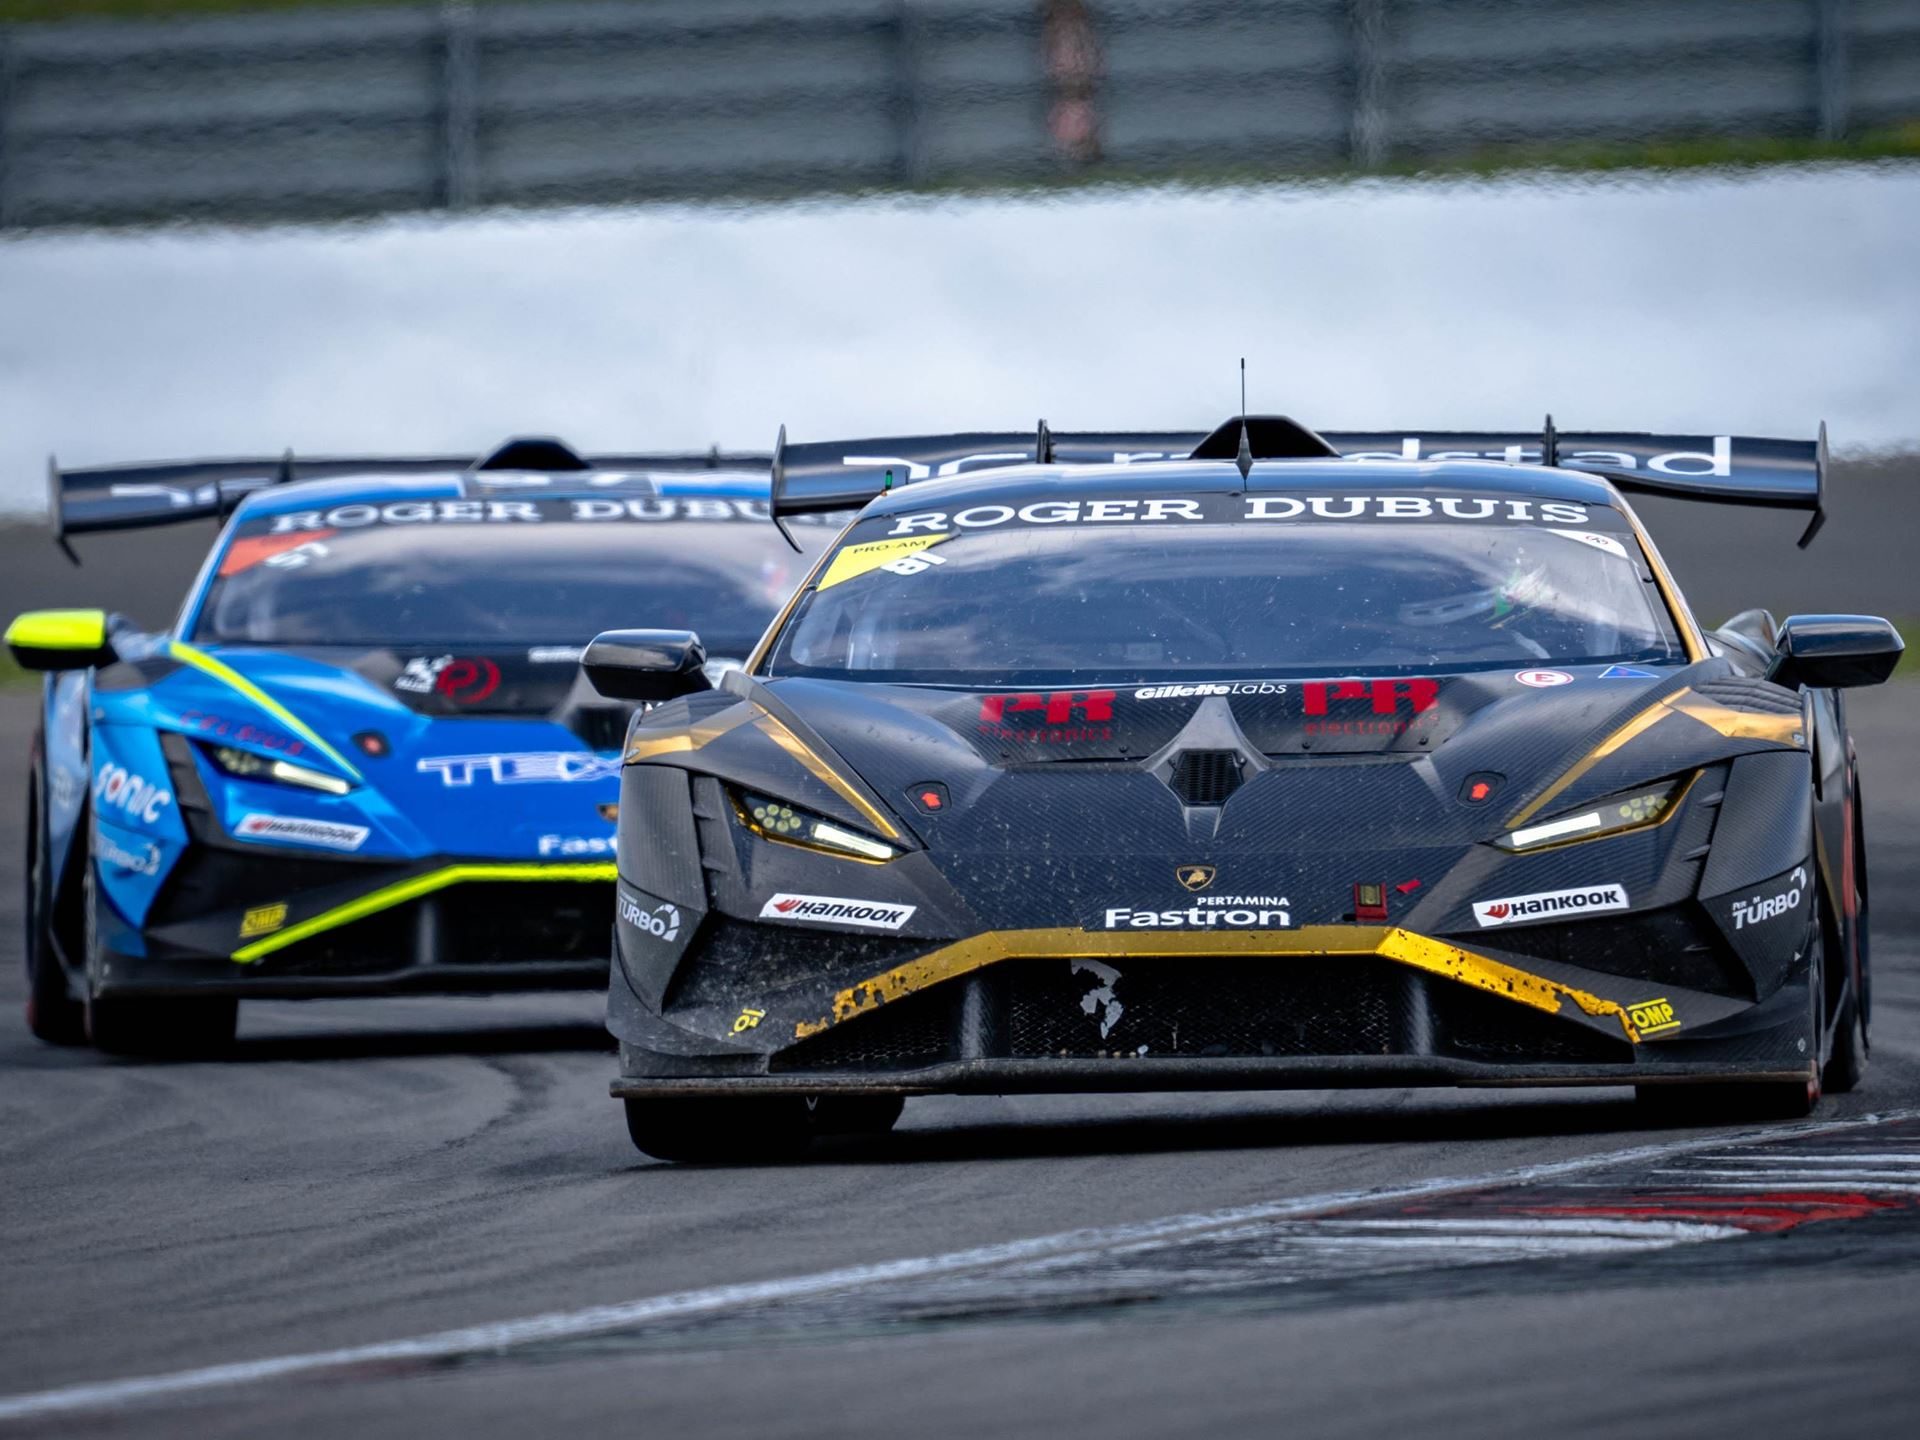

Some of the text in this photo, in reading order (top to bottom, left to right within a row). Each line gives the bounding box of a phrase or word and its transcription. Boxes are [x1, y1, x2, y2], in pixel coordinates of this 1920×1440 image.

[270, 500, 771, 534] ROGER DUBU
[888, 497, 1589, 535] ROGER DUBUIS
[853, 540, 927, 554] PRO-AM
[978, 690, 1116, 723] PR
[1303, 678, 1439, 715] PR
[618, 896, 666, 936] TURBO
[1105, 907, 1290, 928] Fastron
[1197, 896, 1290, 906] PERTAMINA
[1732, 888, 1800, 930] TURBO
[1632, 1002, 1674, 1029] OMP
